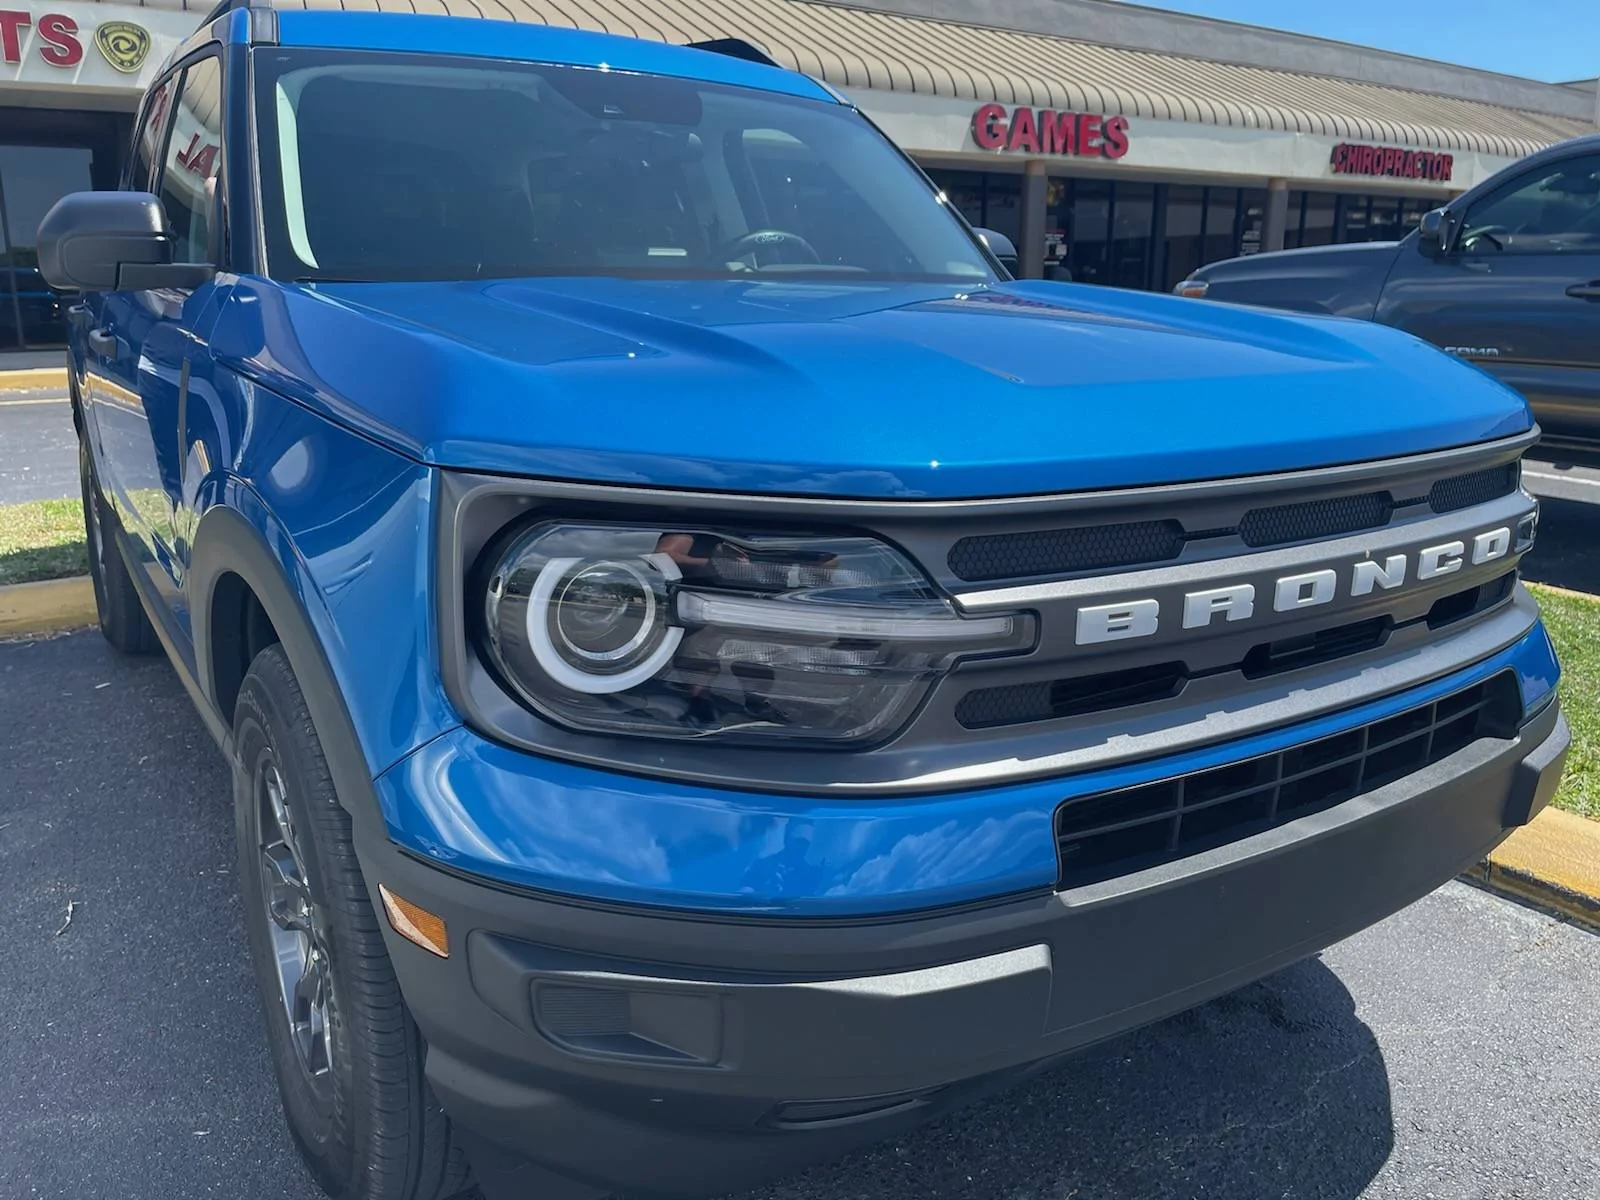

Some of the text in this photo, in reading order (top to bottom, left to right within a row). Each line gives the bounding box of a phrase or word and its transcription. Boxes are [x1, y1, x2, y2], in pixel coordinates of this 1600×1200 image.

[971, 102, 1129, 160] GAMES
[1331, 141, 1453, 182] CHIROPRACTOR
[1076, 526, 1511, 645] BRONCO
